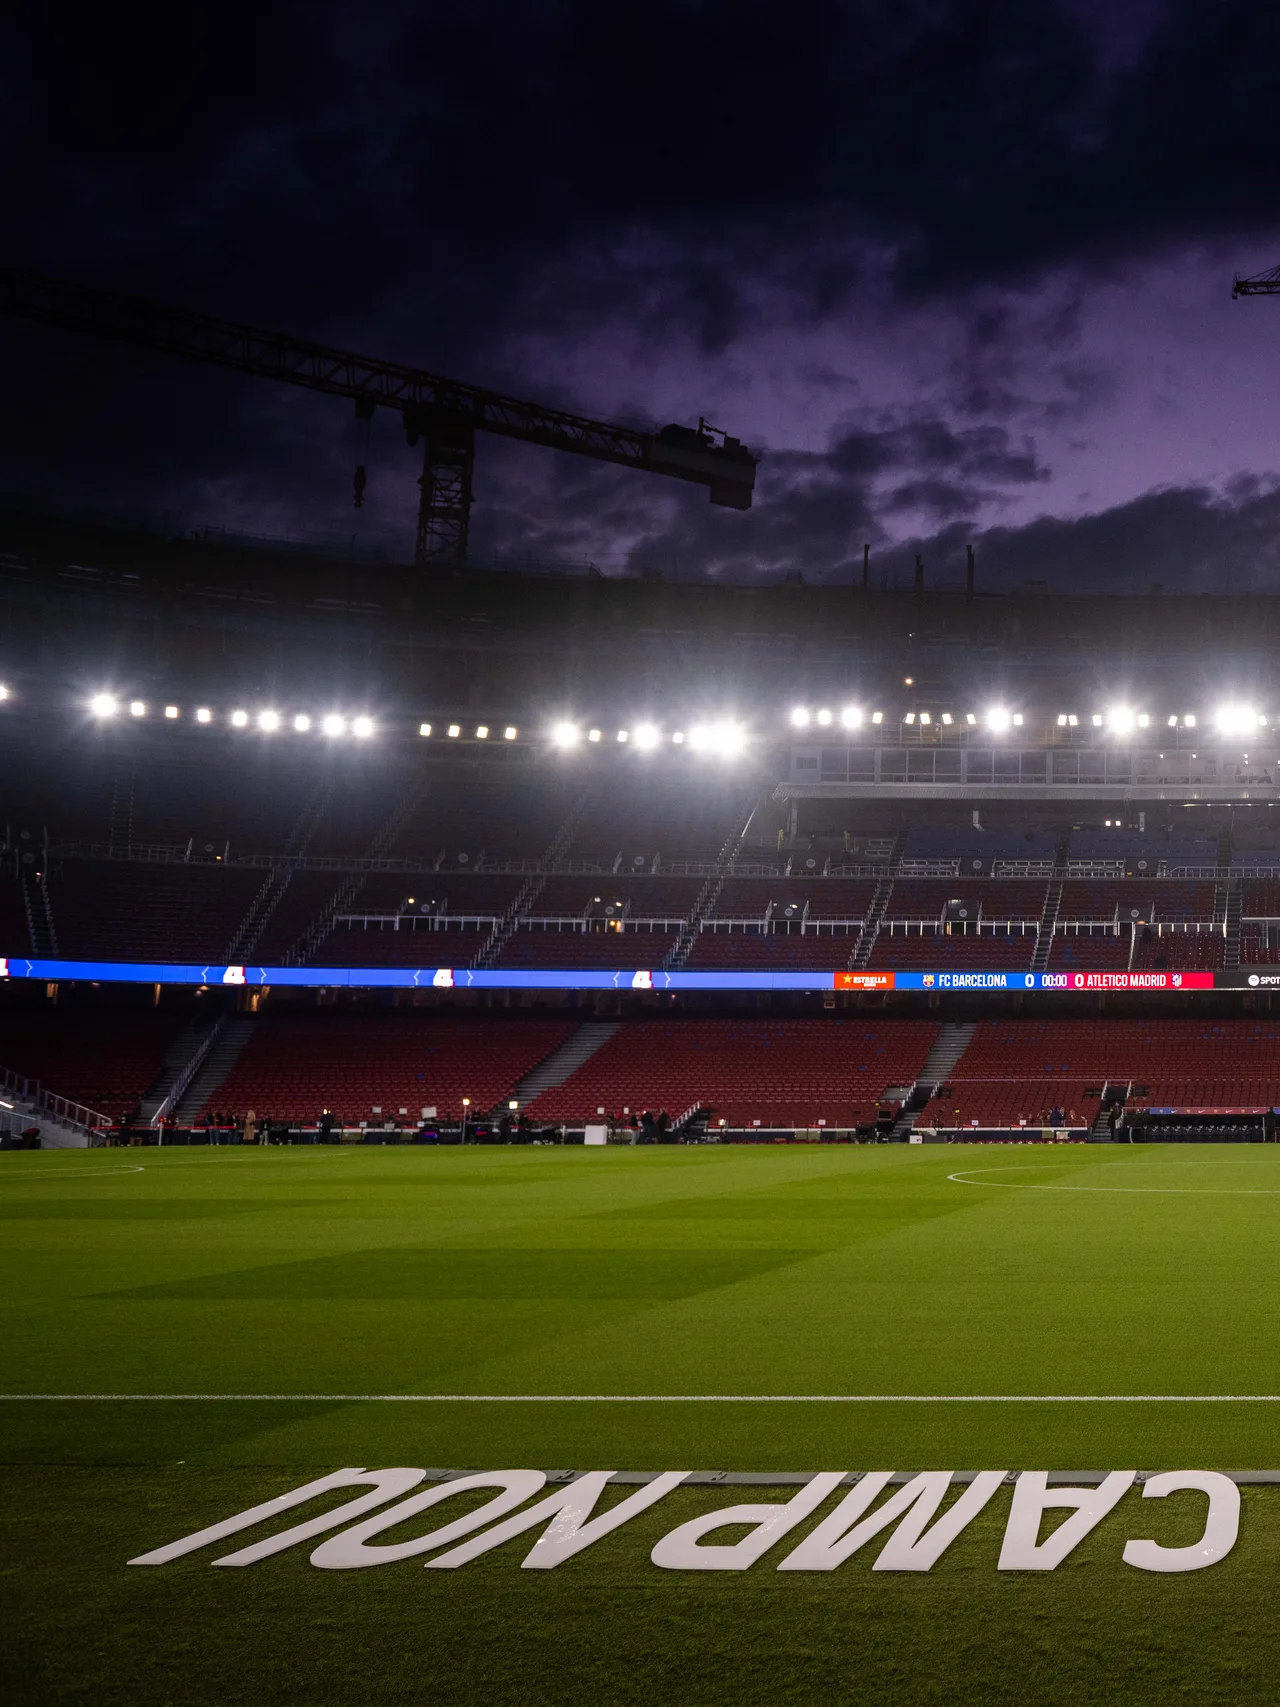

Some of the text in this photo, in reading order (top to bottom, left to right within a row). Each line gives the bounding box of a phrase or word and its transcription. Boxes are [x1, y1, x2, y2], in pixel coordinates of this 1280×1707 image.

[853, 976, 887, 984] ESTRELLA
[938, 974, 1167, 987] FC BARCELONA 0 00:00 0 ATLETICO MADRID
[128, 1467, 693, 1570] NOU
[650, 1470, 1242, 1573] CAMP
